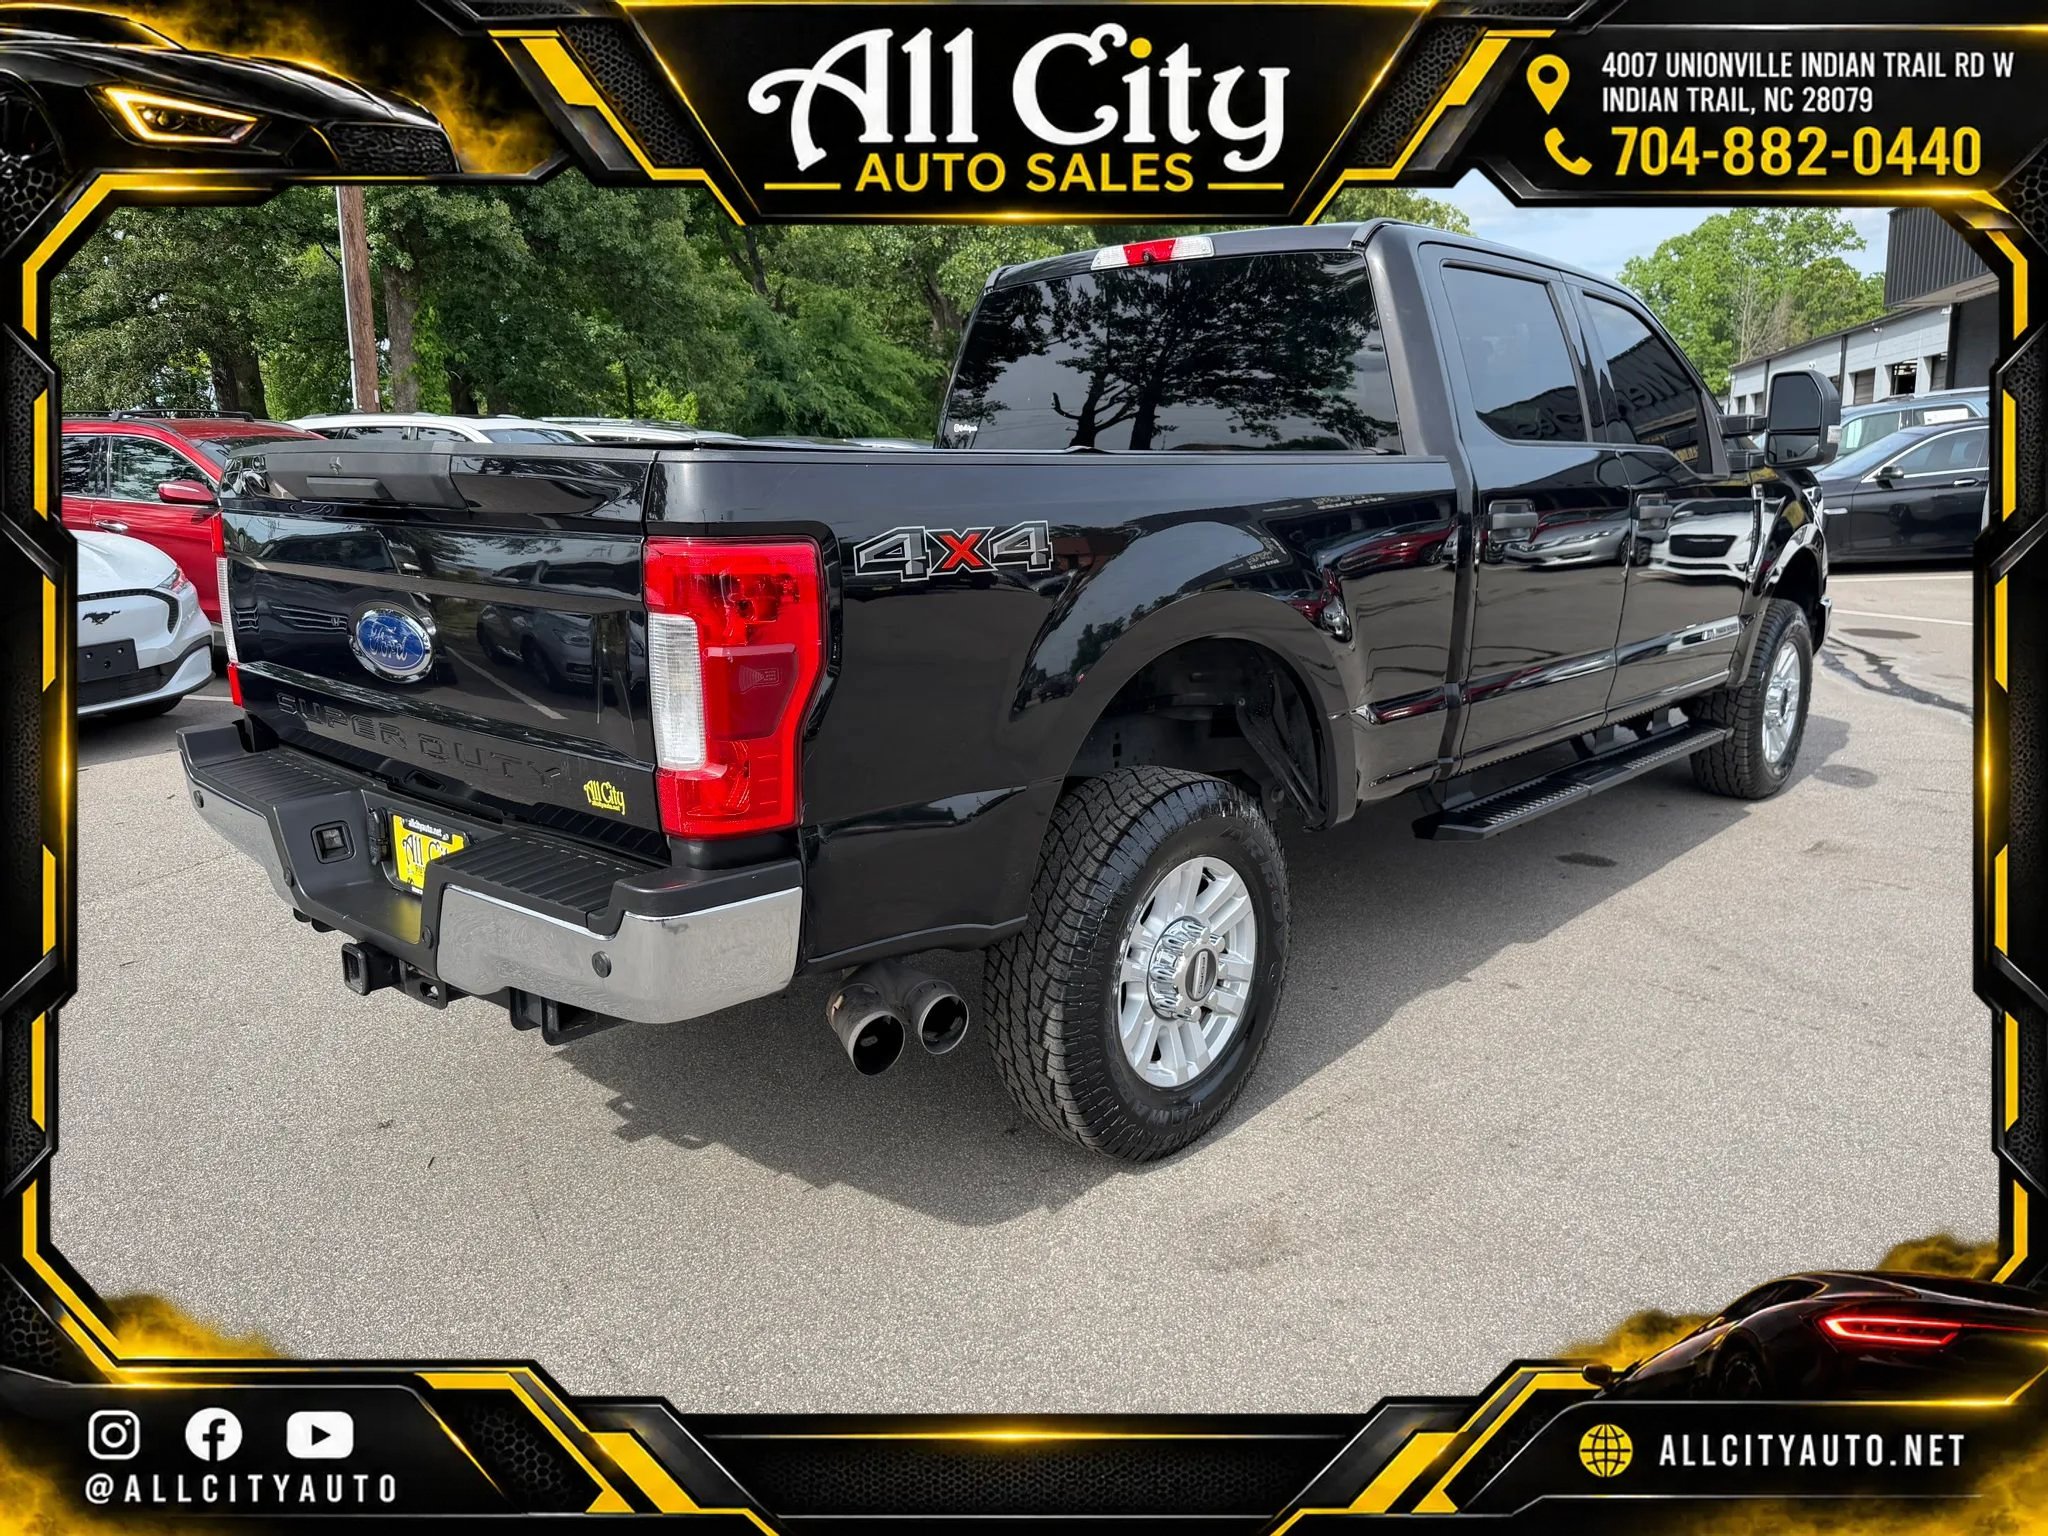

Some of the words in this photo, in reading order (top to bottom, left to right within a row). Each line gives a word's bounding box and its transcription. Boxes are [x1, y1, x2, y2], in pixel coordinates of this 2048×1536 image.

[367, 622, 408, 662] Ford
[276, 692, 408, 750] SUPER
[417, 732, 562, 789] DUTY
[600, 781, 626, 816] City
